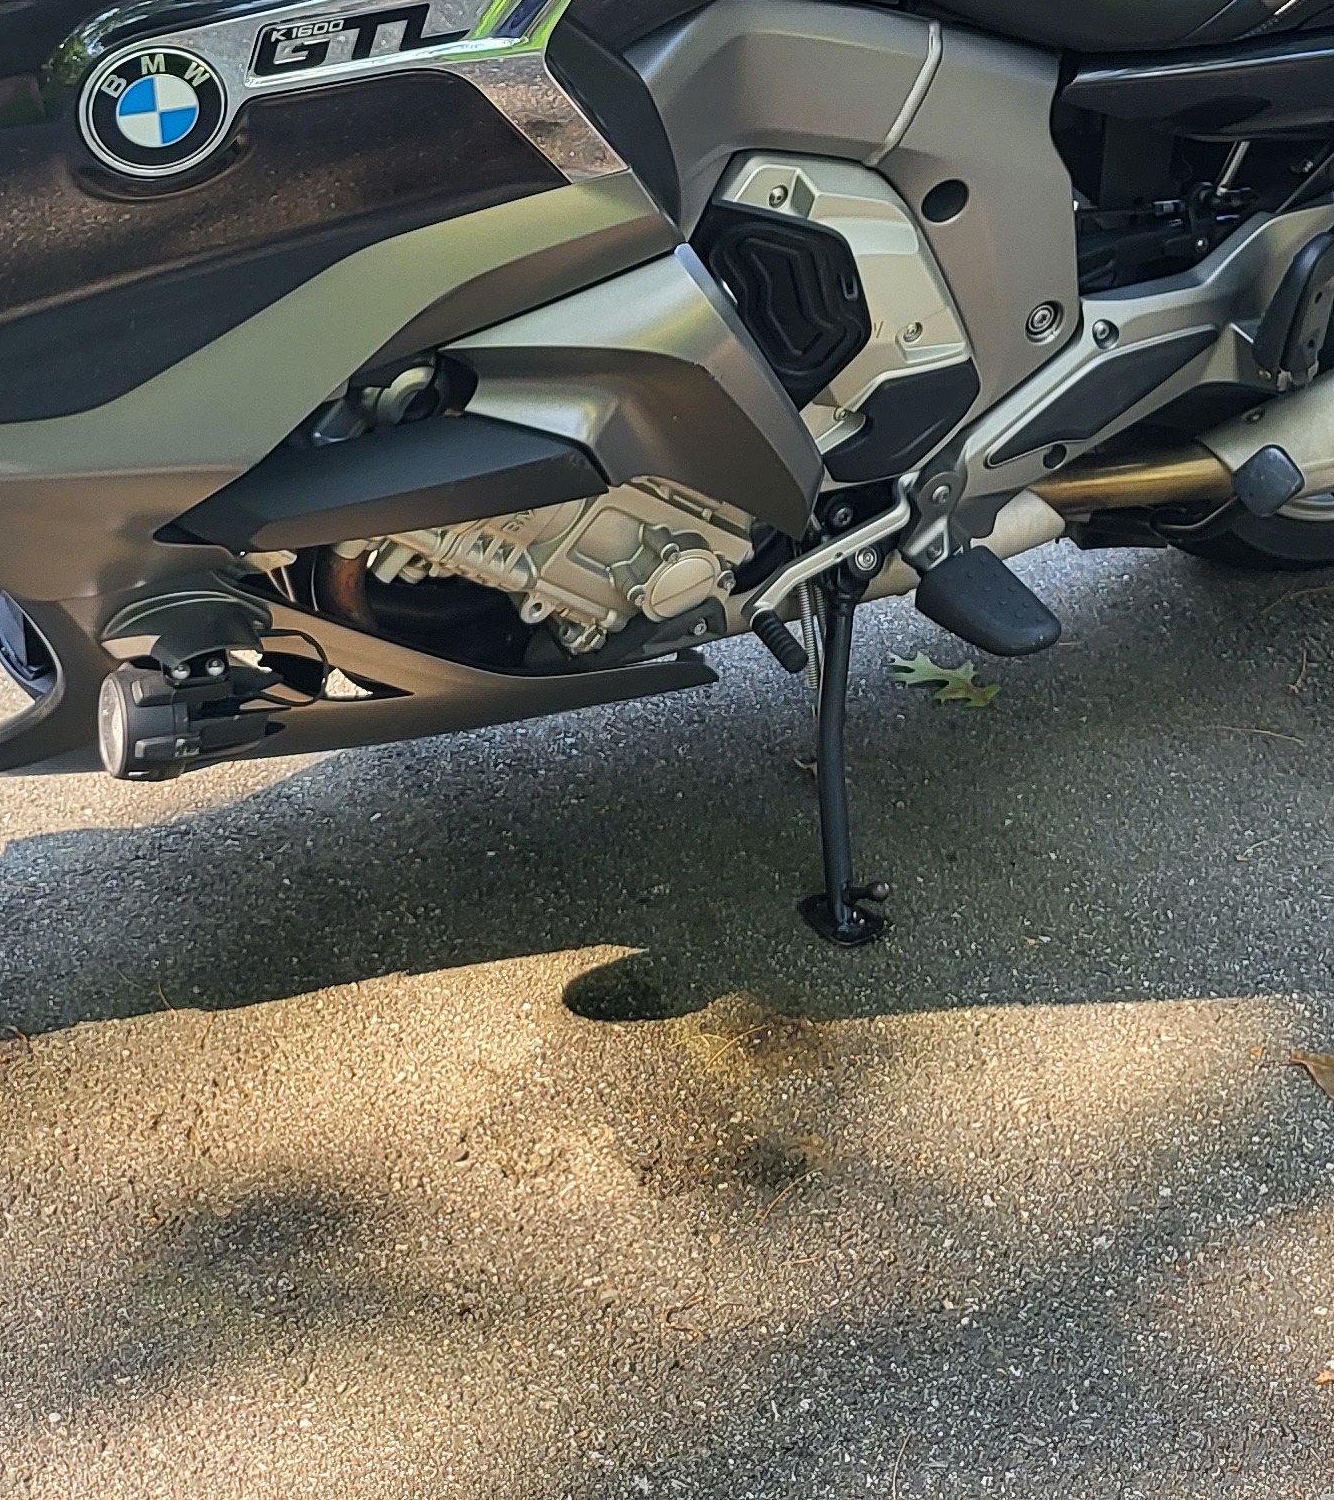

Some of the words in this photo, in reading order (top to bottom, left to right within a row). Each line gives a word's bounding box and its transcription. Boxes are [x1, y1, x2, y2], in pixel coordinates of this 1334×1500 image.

[254, 3, 471, 77] GTL
[271, 28, 288, 42] K
[291, 19, 345, 39] 1600
[100, 53, 211, 99] BMW
